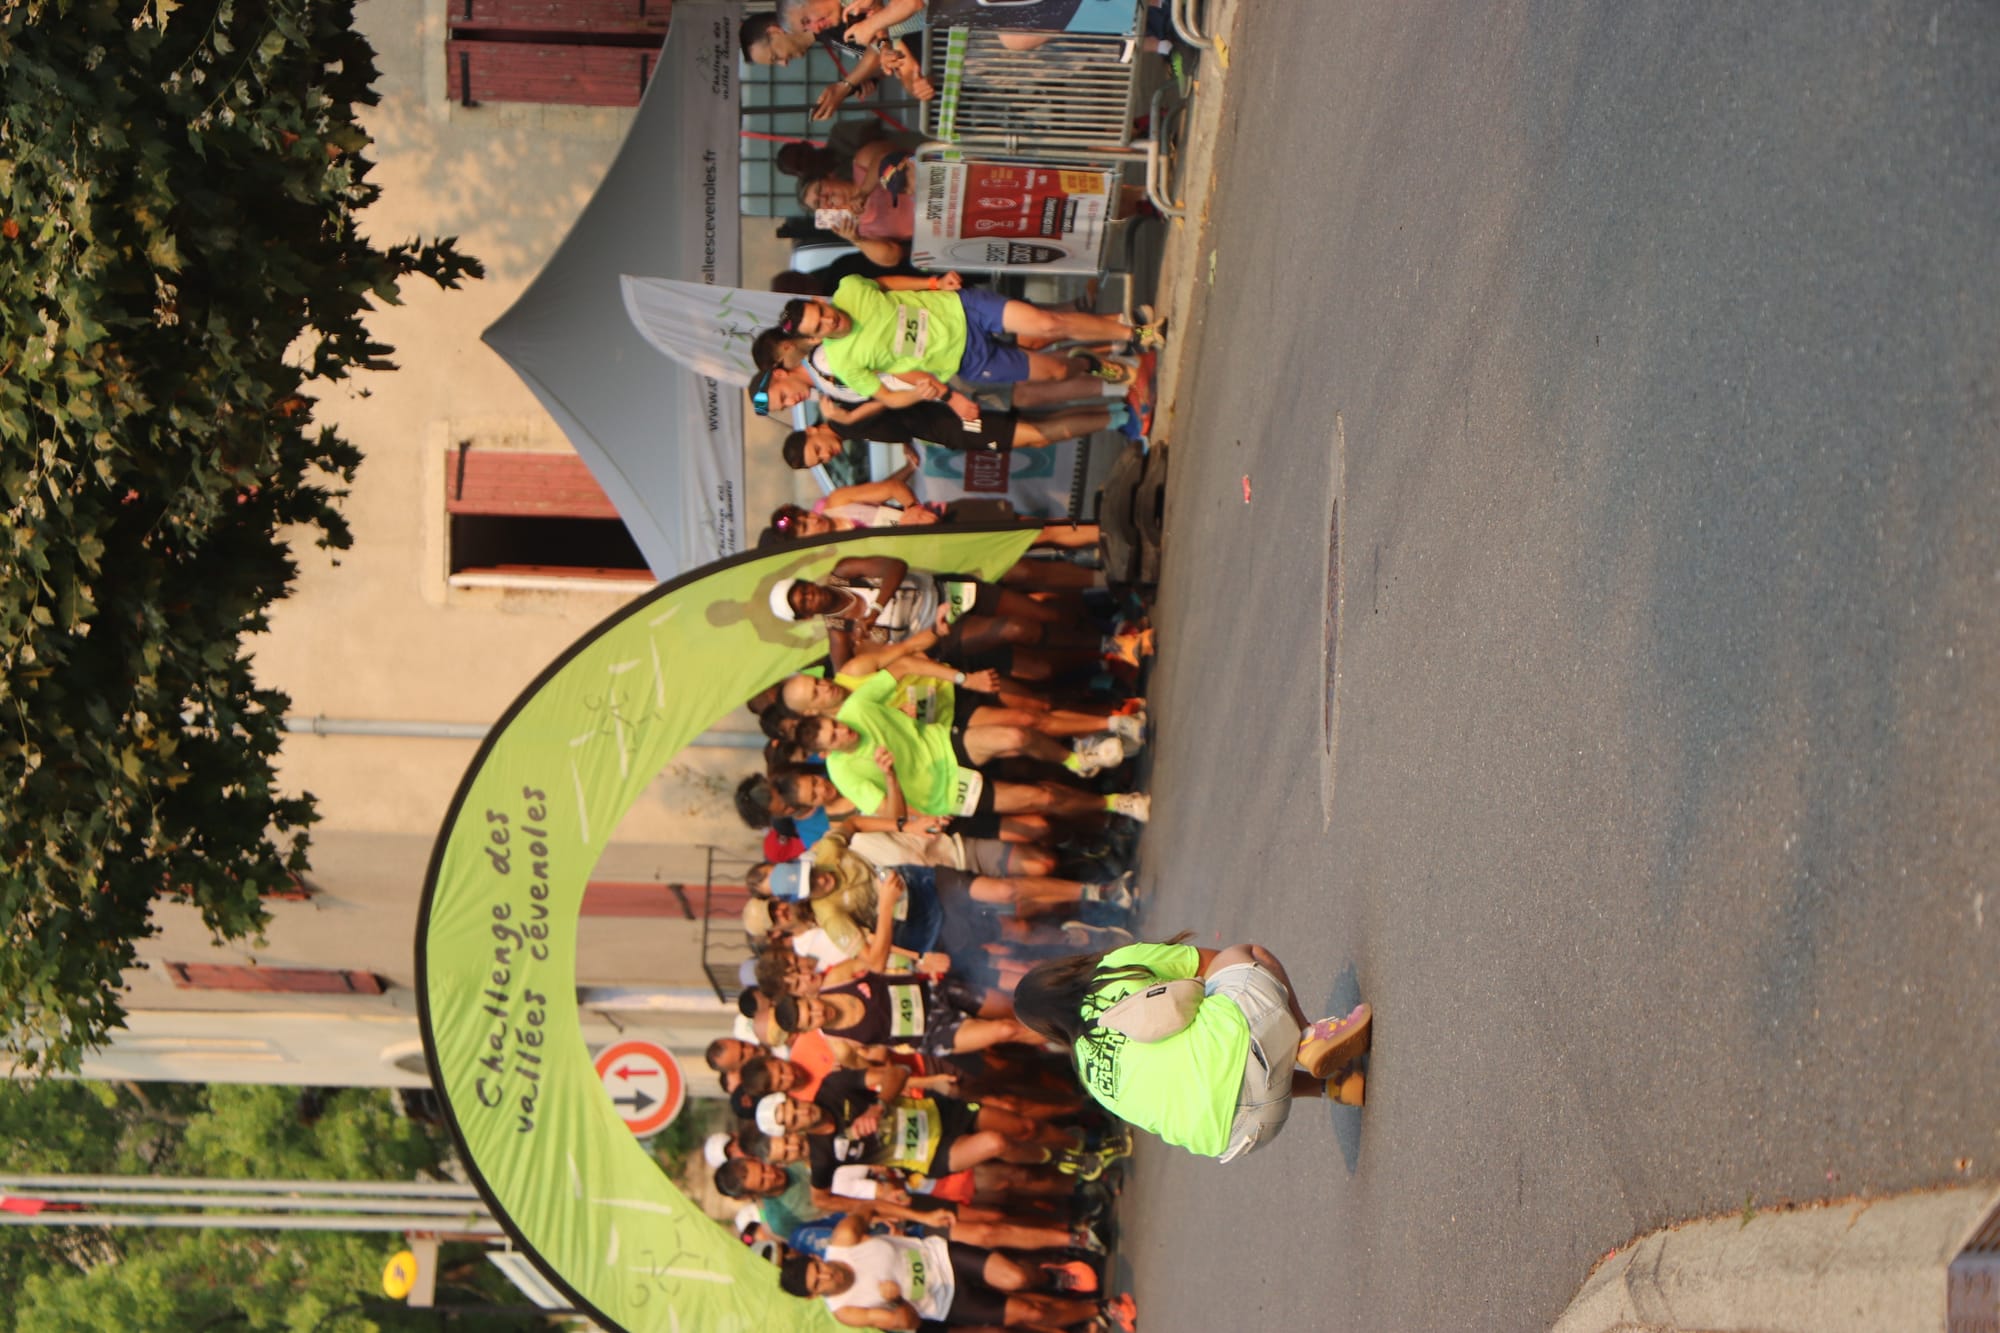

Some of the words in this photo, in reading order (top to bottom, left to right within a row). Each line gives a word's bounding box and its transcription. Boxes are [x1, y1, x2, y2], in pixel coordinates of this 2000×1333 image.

[926, 200, 943, 220] SPORT
[986, 244, 1006, 262] SPORT
[1011, 244, 1032, 262] 2000
[904, 318, 918, 343] 25
[969, 451, 1002, 487] QUÉZ
[484, 808, 511, 875] des
[519, 784, 550, 962] cévenoles
[475, 902, 523, 1108] Challenge
[900, 998, 912, 1022] 49
[514, 988, 547, 1134] vallées
[906, 1116, 919, 1151] 124
[912, 1261, 925, 1286] 20
